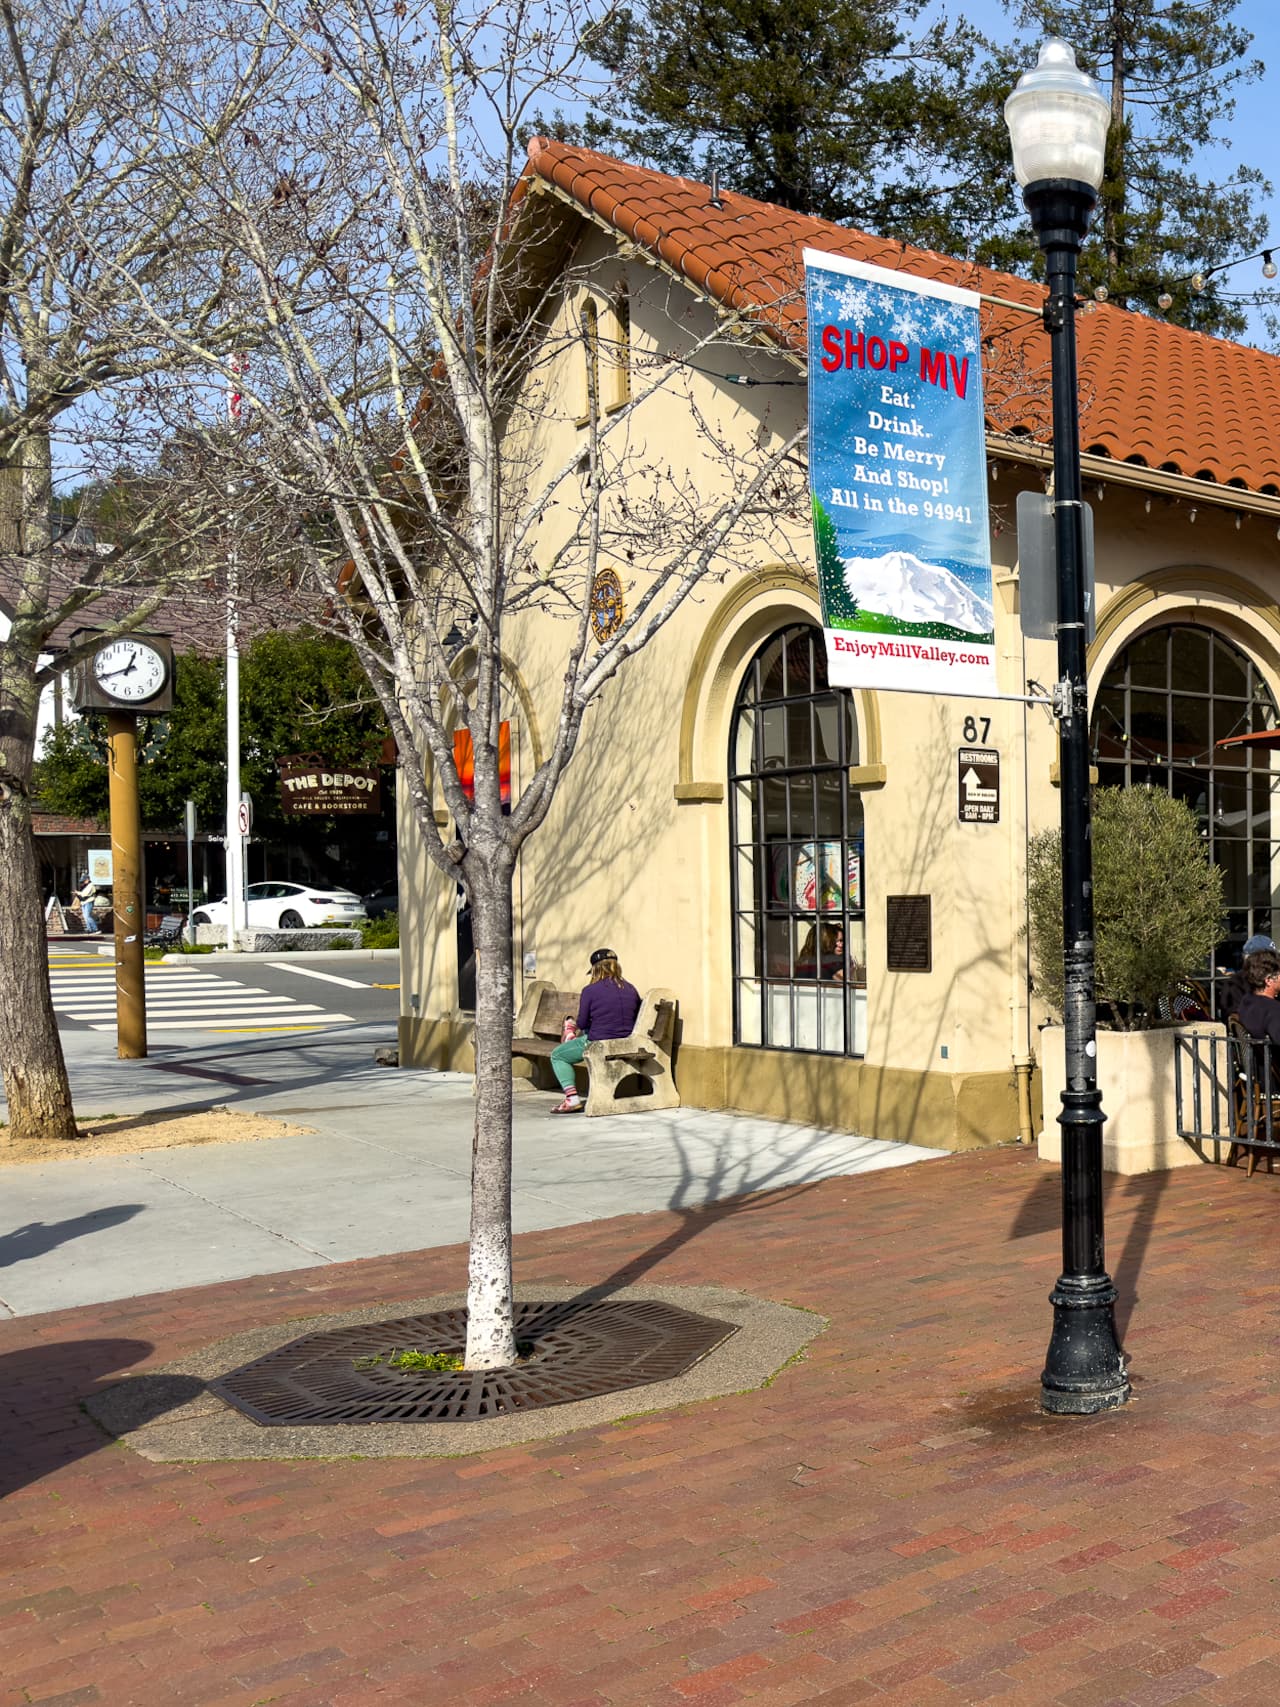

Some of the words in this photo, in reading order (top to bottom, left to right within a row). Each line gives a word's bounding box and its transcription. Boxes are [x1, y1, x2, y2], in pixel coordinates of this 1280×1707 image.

[820, 325, 910, 373] SHOP
[919, 347, 969, 400] MV
[881, 385, 916, 409] Eat.
[868, 411, 931, 438] Drink.
[854, 436, 879, 457] Be
[883, 441, 946, 471] Merry
[853, 464, 893, 486] And
[897, 470, 949, 497] Shop!
[830, 488, 859, 508] All
[863, 493, 884, 512] in
[888, 497, 919, 516] the
[923, 501, 972, 524] 94941
[112, 644, 121, 654] 11
[123, 643, 134, 652] 12
[139, 648, 143, 656] 1
[833, 637, 989, 666] EnjoyMillValley.com
[102, 651, 112, 660] 10
[147, 655, 155, 665] 2
[152, 667, 159, 677] 3
[111, 682, 118, 692] 7
[147, 678, 153, 687] 4
[124, 687, 131, 696] 6
[137, 685, 144, 695] 5
[963, 716, 991, 744] 87
[960, 752, 998, 763] RESTROOMS
[283, 774, 318, 792] THE
[321, 773, 377, 792] DEPOT
[964, 804, 979, 812] OPEN
